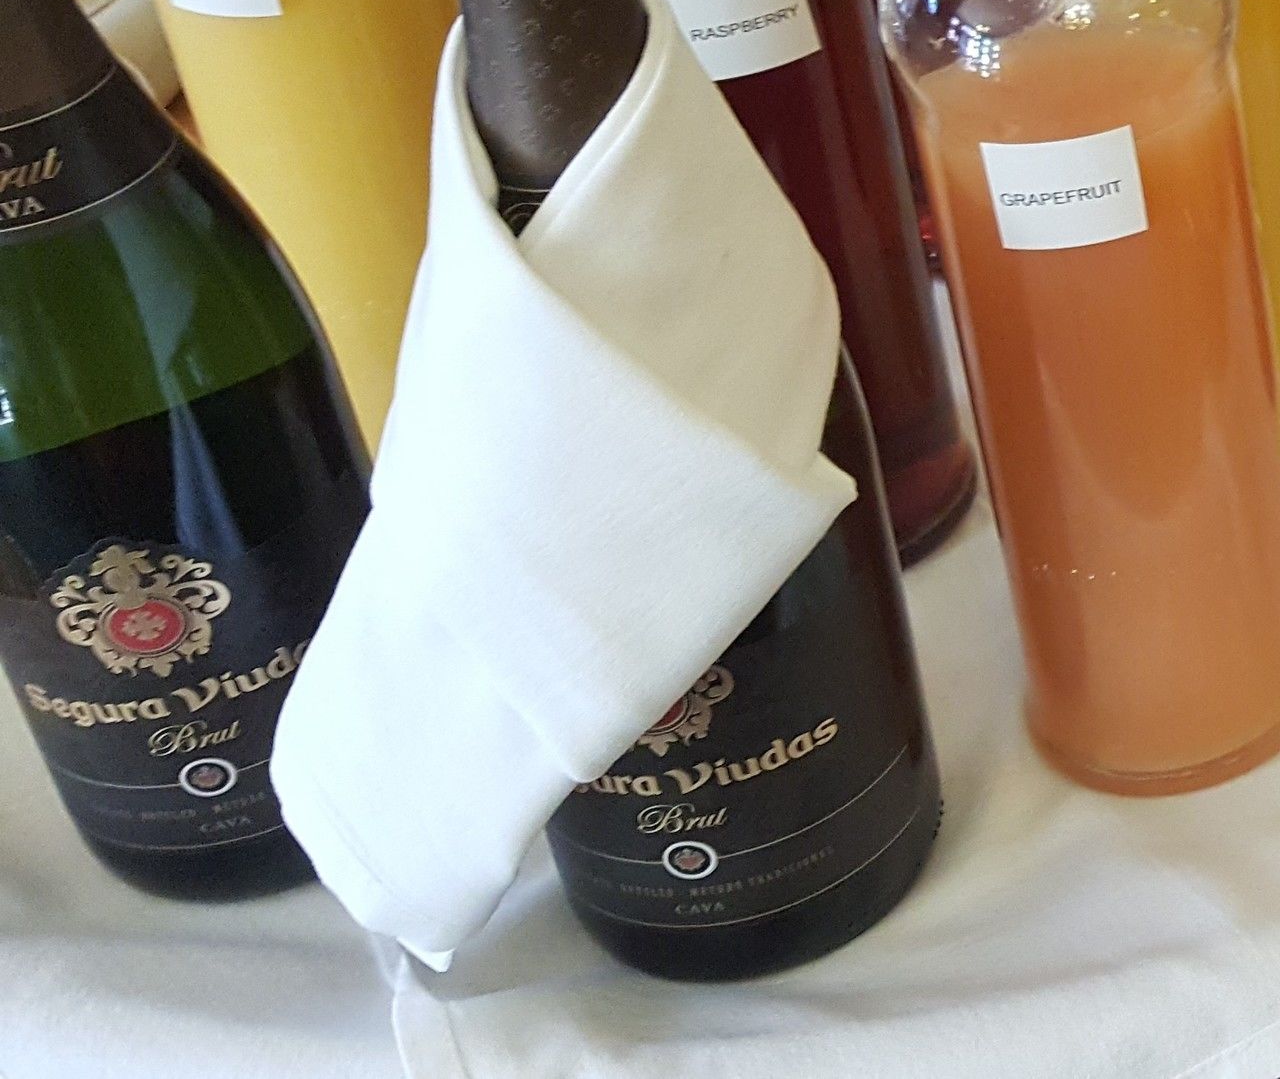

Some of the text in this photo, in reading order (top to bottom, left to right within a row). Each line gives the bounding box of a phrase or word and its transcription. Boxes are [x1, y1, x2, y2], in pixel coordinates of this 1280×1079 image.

[690, 3, 800, 42] RASPBERRY
[1000, 180, 1122, 208] GRAPEFRUIT
[25, 640, 308, 728] Segura Viud
[148, 720, 243, 757] Brut
[663, 717, 840, 796] Viudas
[636, 802, 728, 834] Brut
